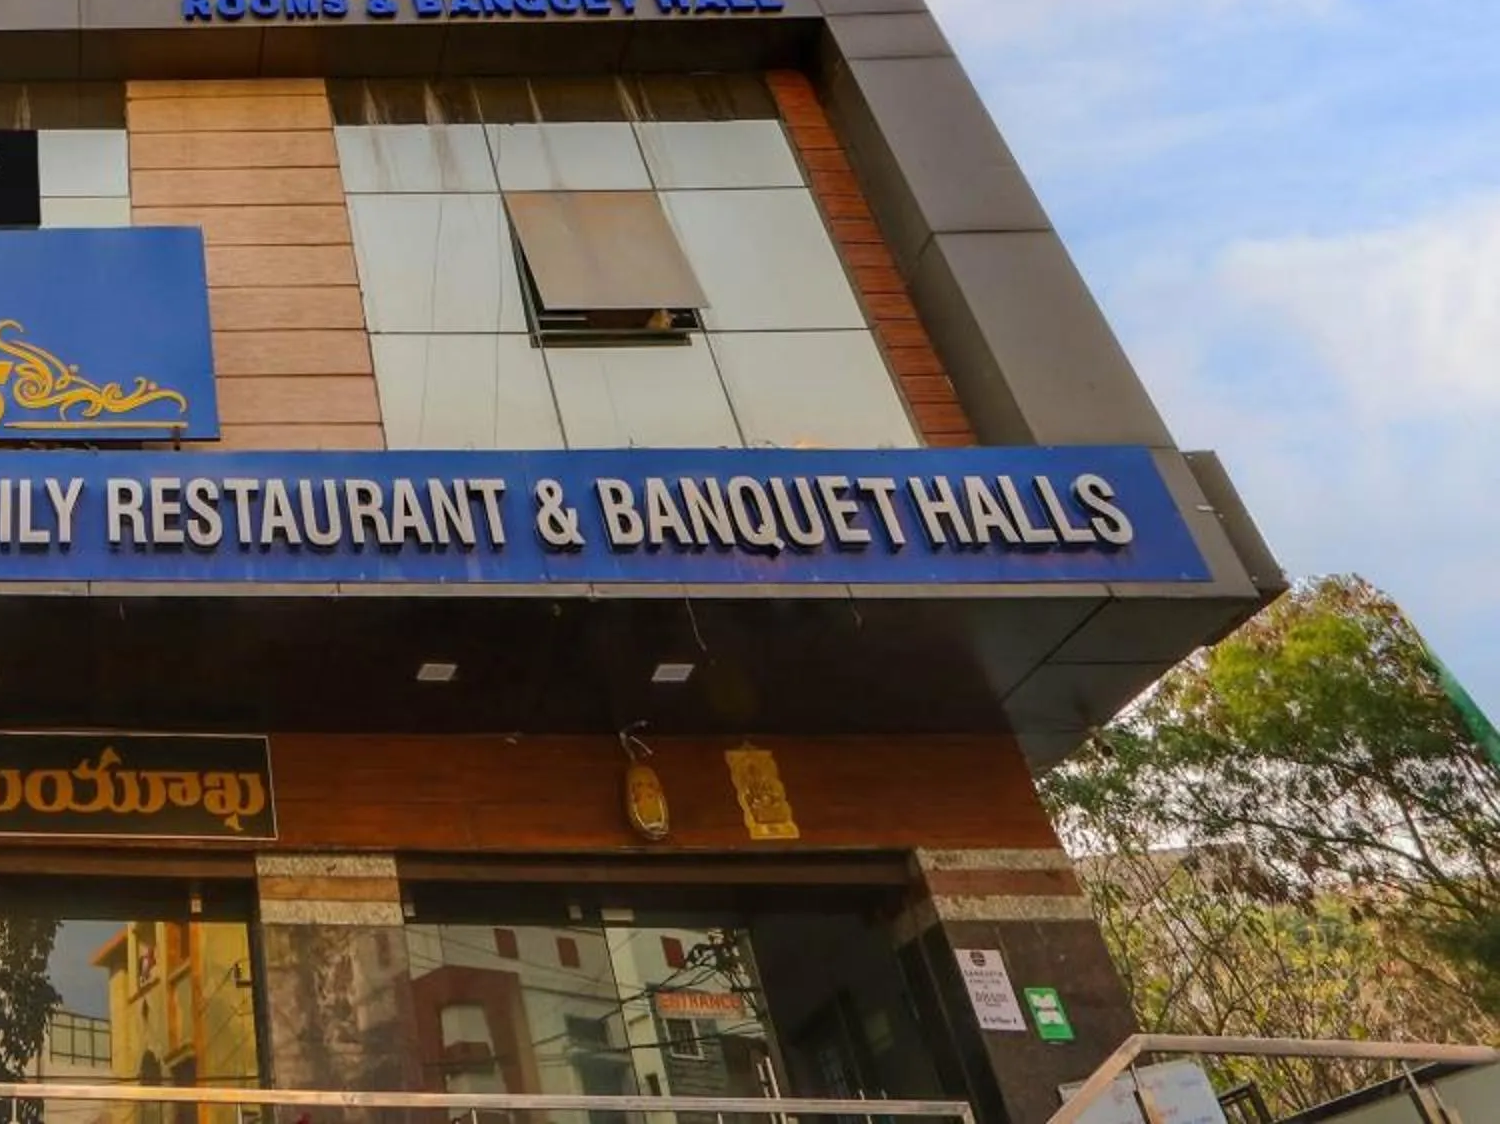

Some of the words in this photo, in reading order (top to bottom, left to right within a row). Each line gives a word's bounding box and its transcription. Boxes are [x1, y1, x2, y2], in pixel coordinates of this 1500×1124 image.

[107, 477, 506, 549] RESTAURANT
[534, 479, 586, 550] &
[595, 475, 906, 555] BANQUET
[906, 473, 1134, 547] HALLS
